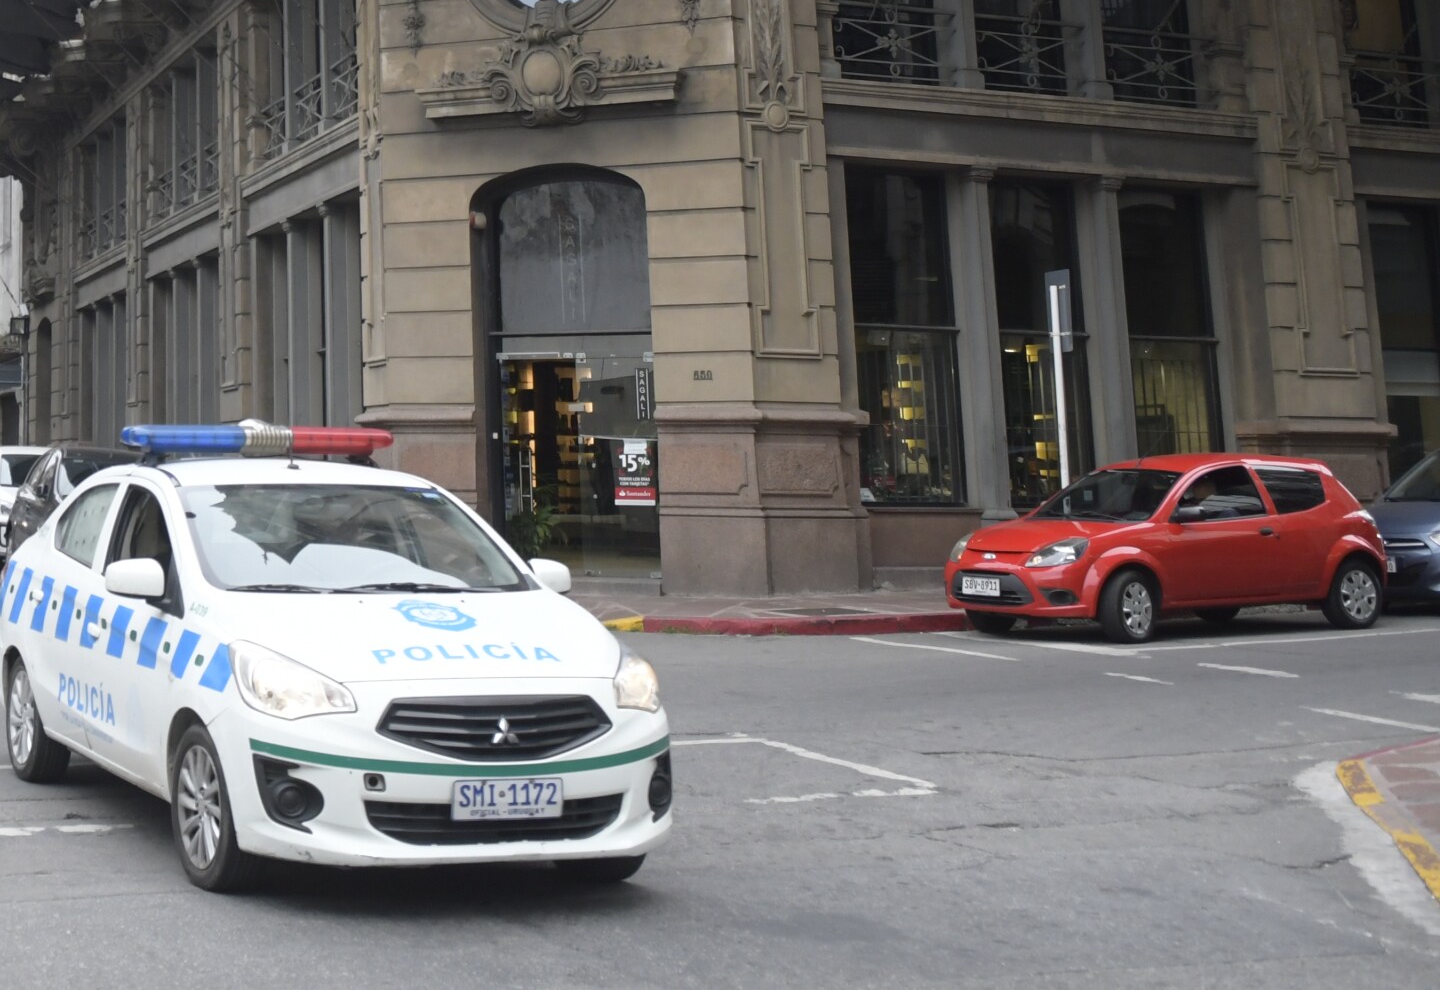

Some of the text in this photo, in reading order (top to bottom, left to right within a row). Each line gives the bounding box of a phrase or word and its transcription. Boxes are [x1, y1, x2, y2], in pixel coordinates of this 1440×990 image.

[564, 217, 577, 321] SAGALI
[618, 454, 651, 472] 15%
[371, 642, 561, 664] POLICÍA
[57, 672, 116, 726] POLICÍA
